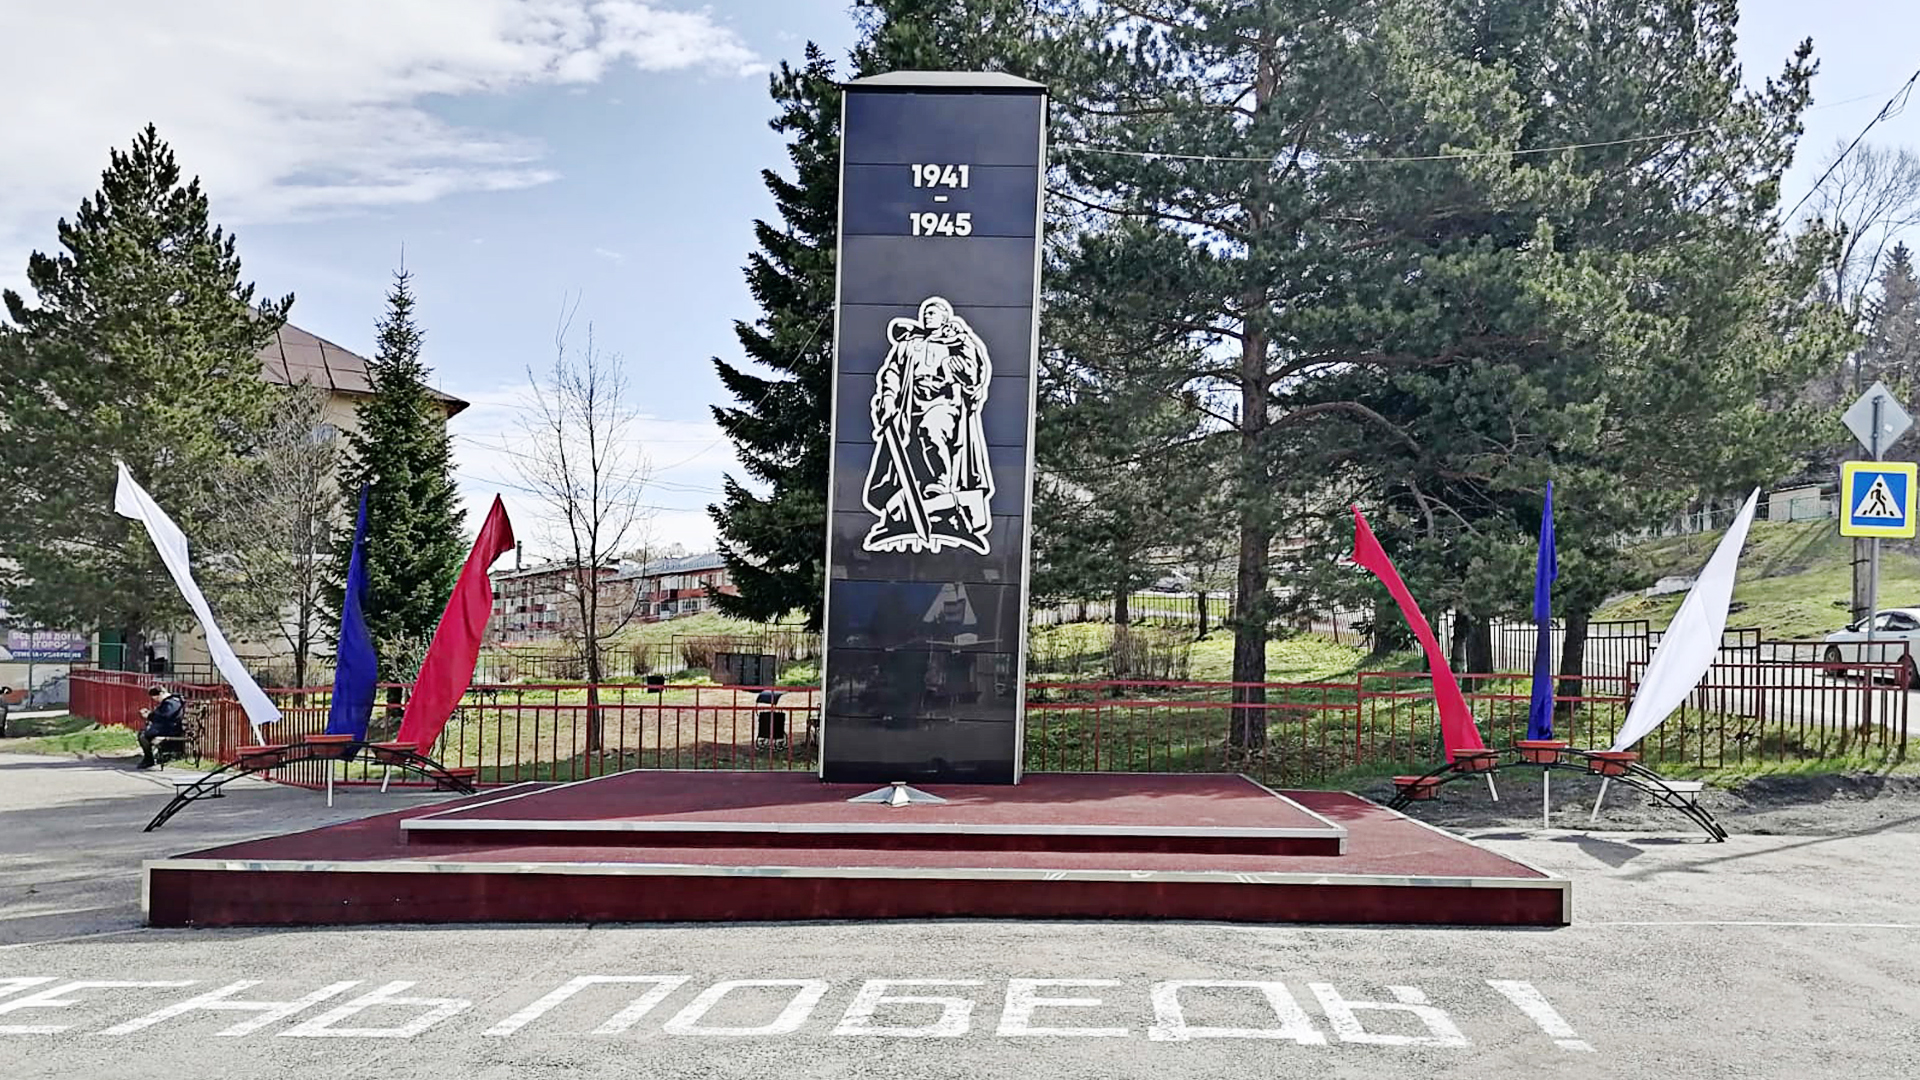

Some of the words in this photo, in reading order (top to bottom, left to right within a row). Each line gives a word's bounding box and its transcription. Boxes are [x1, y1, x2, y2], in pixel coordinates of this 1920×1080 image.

[911, 163, 969, 188] 1941
[909, 212, 972, 236] 1945
[0, 976, 472, 1037] ЕНЬ
